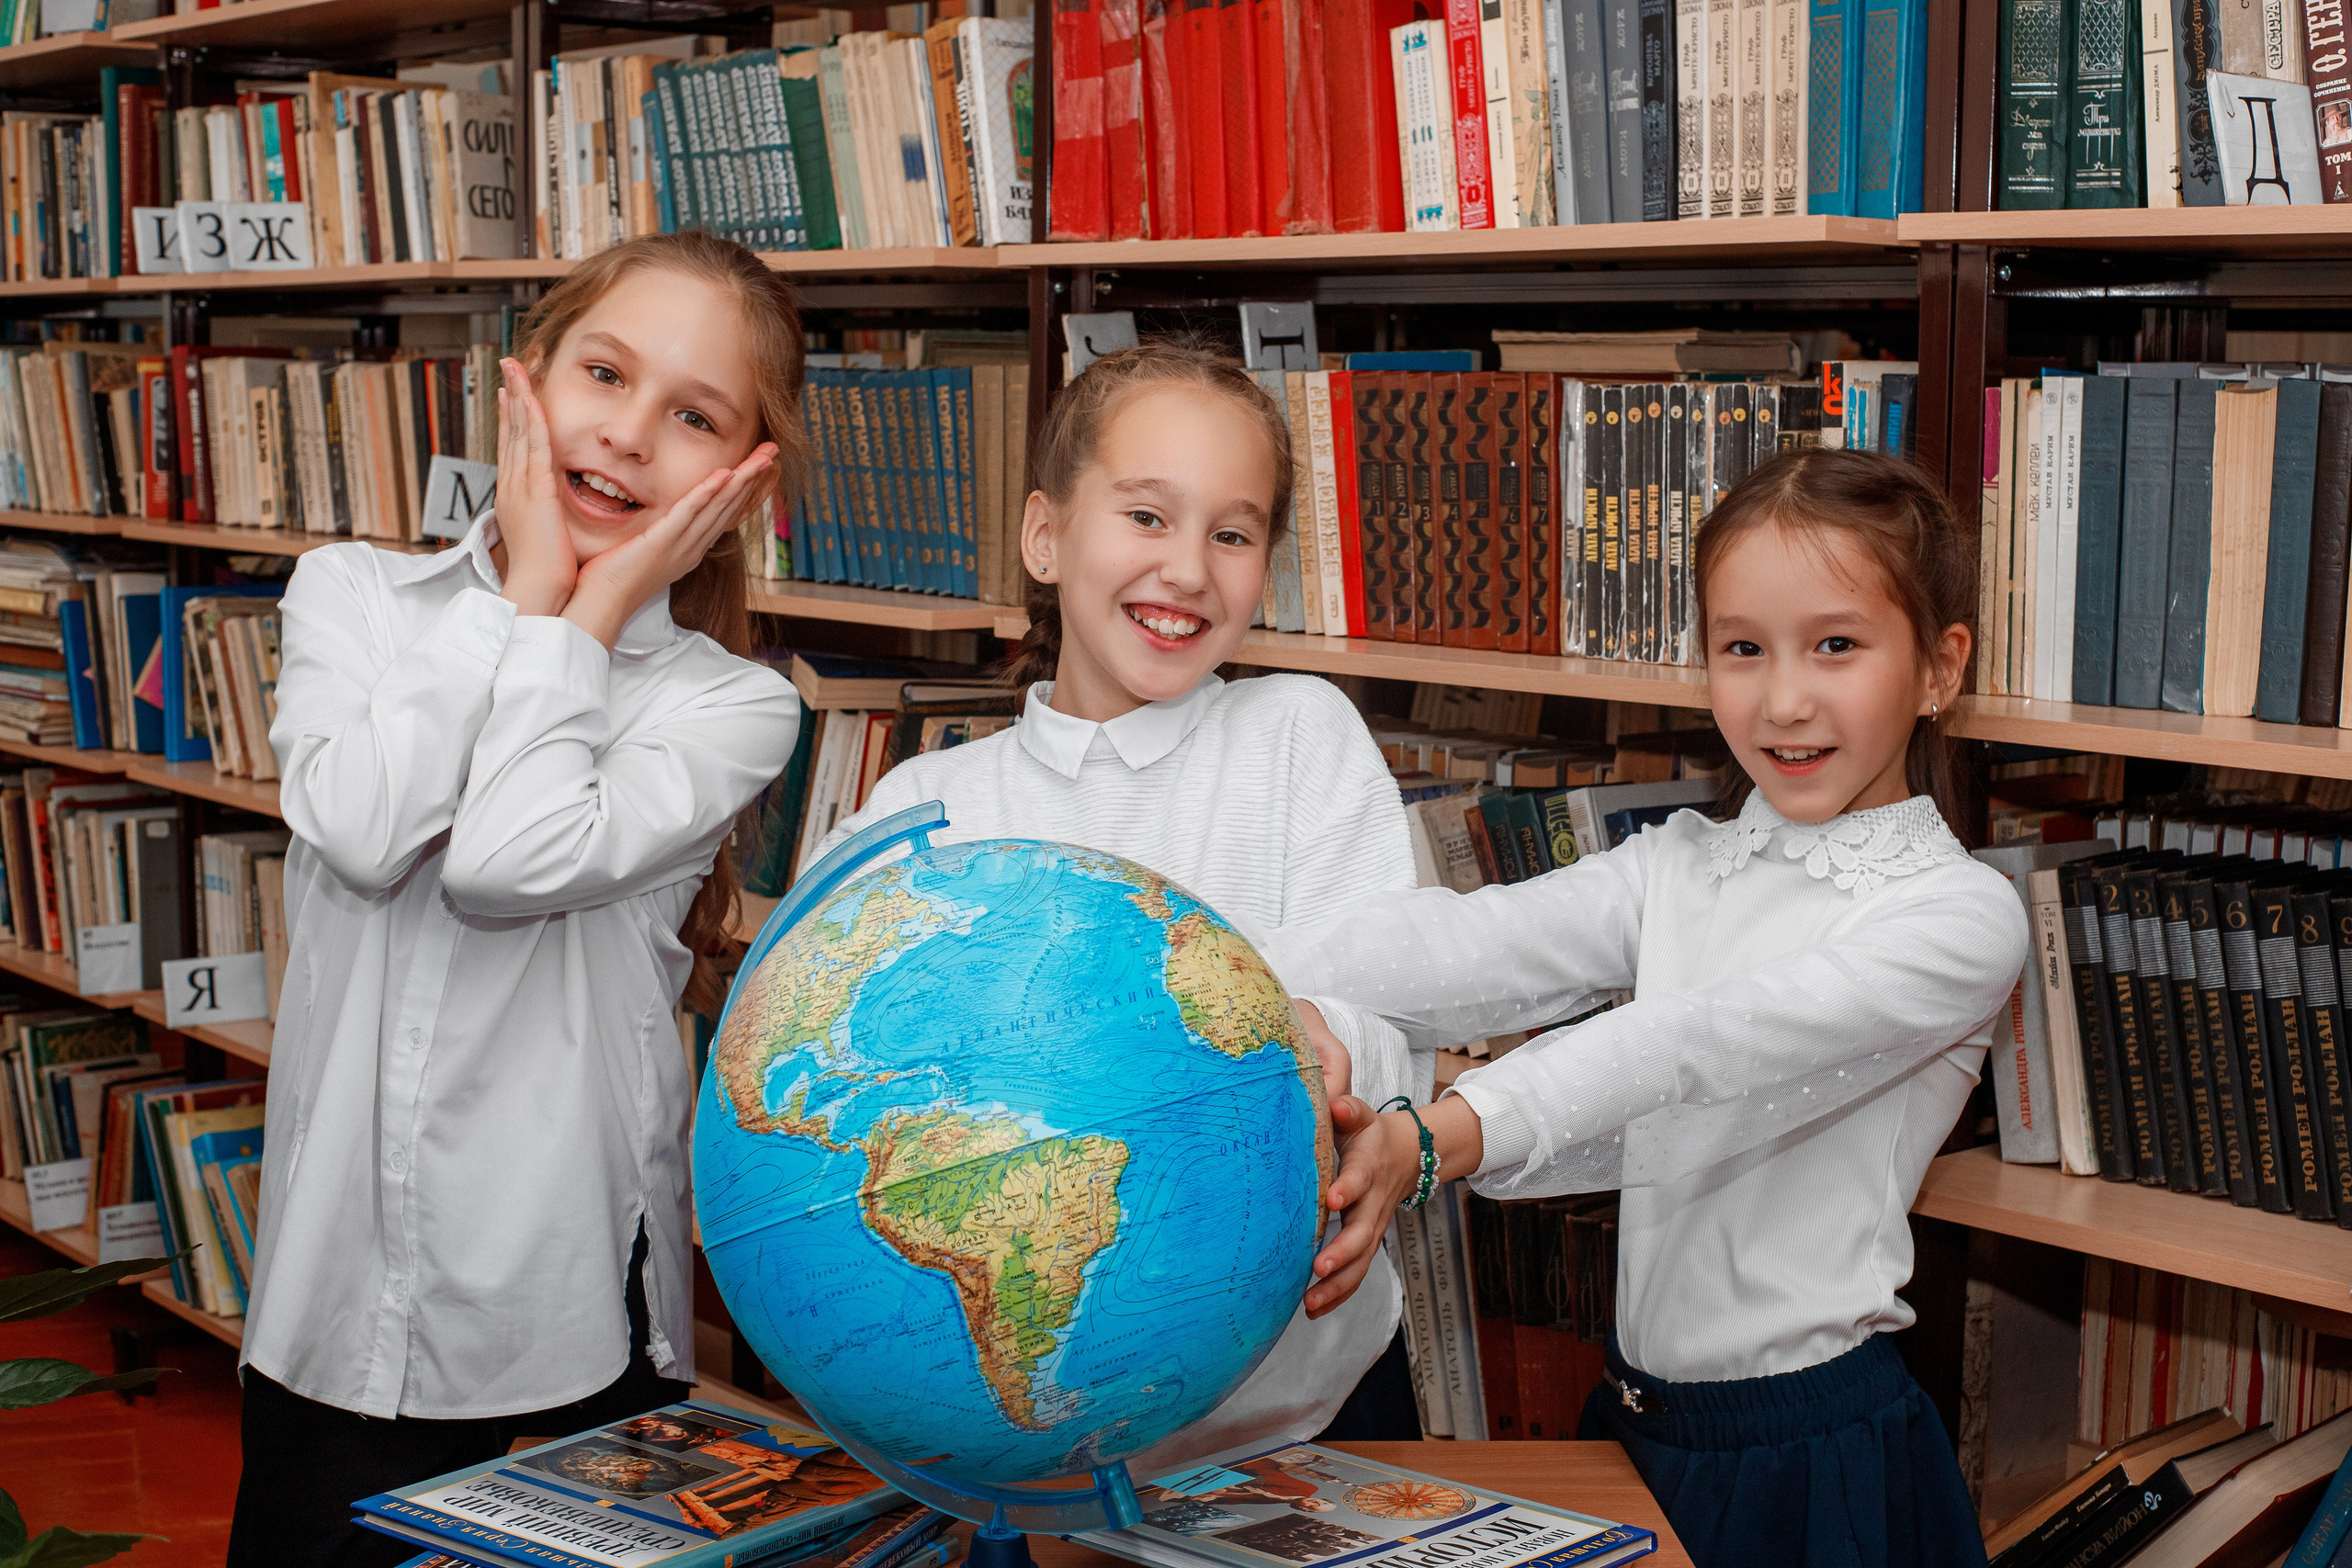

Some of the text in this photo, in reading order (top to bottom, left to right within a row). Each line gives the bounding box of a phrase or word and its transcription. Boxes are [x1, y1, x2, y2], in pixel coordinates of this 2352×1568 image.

[2313, 85, 2351, 98] СОЧИНЕНИЙ
[2315, 78, 2347, 90] СОБРАНИЕ
[2238, 96, 2291, 206] Д
[2325, 152, 2351, 166] ТОМ
[240, 217, 299, 262] Ж
[936, 385, 955, 470] ЛОНДОН
[1375, 502, 1381, 515] 1
[1398, 502, 1407, 515] 2
[1423, 506, 1430, 521] 3
[1451, 506, 1458, 521] 4
[1539, 507, 1547, 522] 7
[1586, 488, 1598, 563] АГАТА КРИСТИ
[1629, 489, 1641, 564] АГАТА КРИСТИ
[1647, 484, 1659, 560] АГАТА КРИСТИ
[1670, 491, 1682, 567] АГАТА КРИСТИ
[1606, 496, 1618, 570] АГАТА КРИСТИ
[1521, 827, 1540, 877] ОМАНЫ
[2071, 880, 2082, 906] 1
[2102, 884, 2120, 912] 2
[2134, 889, 2154, 917] 3
[2164, 895, 2183, 919] 4
[2190, 899, 2209, 927] 5
[2225, 900, 2247, 929] 6
[2267, 905, 2283, 934] 7
[2301, 915, 2319, 943] 8
[182, 966, 223, 1012] Я
[941, 987, 1270, 1156] АТЛАНТИЧЕСКИЙ ОКЕАН
[2017, 1051, 2032, 1131] АЛЕКСАНДРА
[2116, 976, 2154, 1160] РОМЕН РОЛЛАН
[2179, 985, 2216, 1175] РОМЕН РОЛЛАН
[2206, 990, 2243, 1180] РОМЕН РОЛЛАН
[2241, 994, 2276, 1186] РОМЕН РОЛЛАН
[2281, 998, 2318, 1192] РОМЕН РОЛЛАН
[1432, 1224, 1463, 1396] АНАТОЛЬ ФРАНС
[999, 1339, 1046, 1358] АРГЕНТИНА
[1415, 1292, 1436, 1385] АНАТОЛЬ
[442, 1495, 653, 1558] ДРЕВНИЙ МИР
[464, 1479, 686, 1551] СРЕДНЕВЕКОВЬЕ
[1514, 1528, 1577, 1551] НОВАЯ
